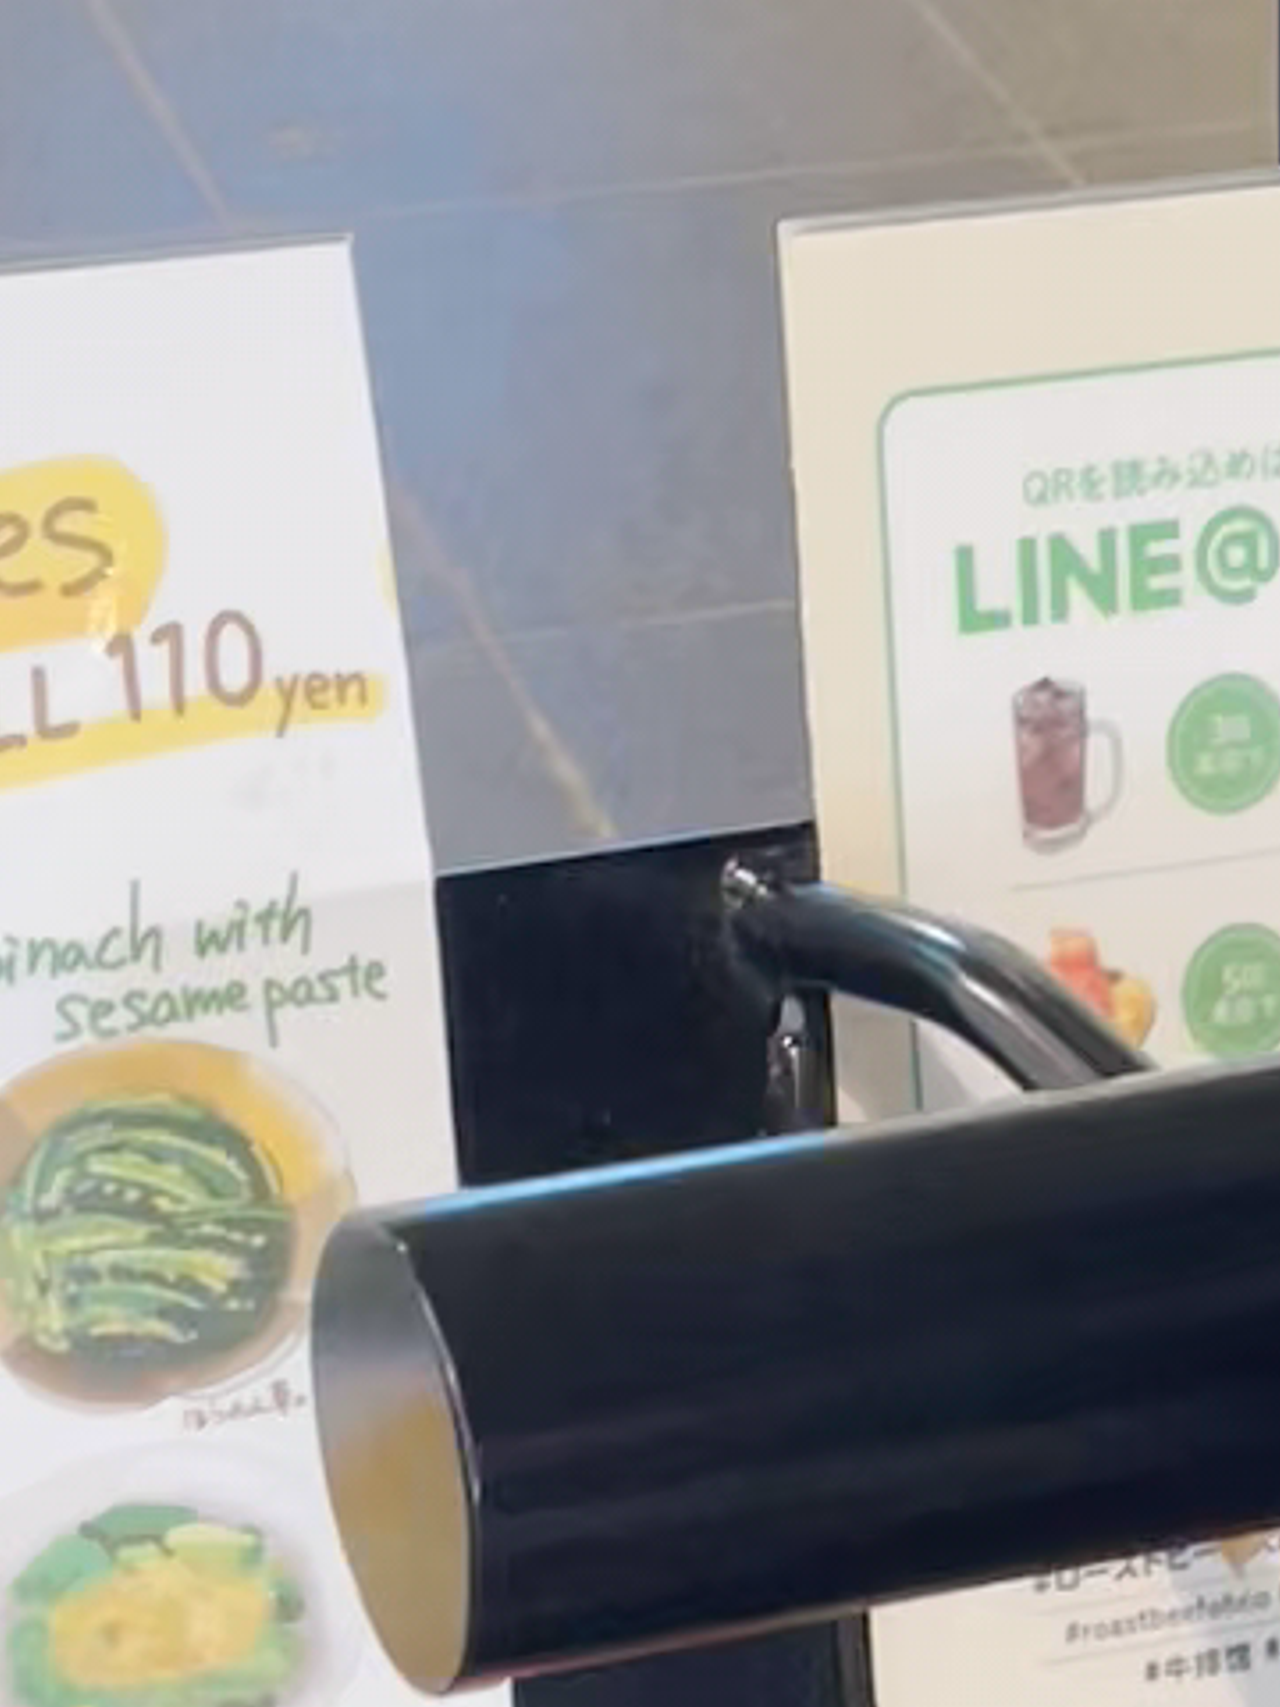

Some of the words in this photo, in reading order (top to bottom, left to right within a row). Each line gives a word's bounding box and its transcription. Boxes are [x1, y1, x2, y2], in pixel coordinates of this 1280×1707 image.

[104, 608, 263, 730] 110
[276, 663, 369, 736] yen
[192, 873, 314, 958] with
[55, 973, 254, 1044] sesame
[262, 955, 389, 1048] paste
